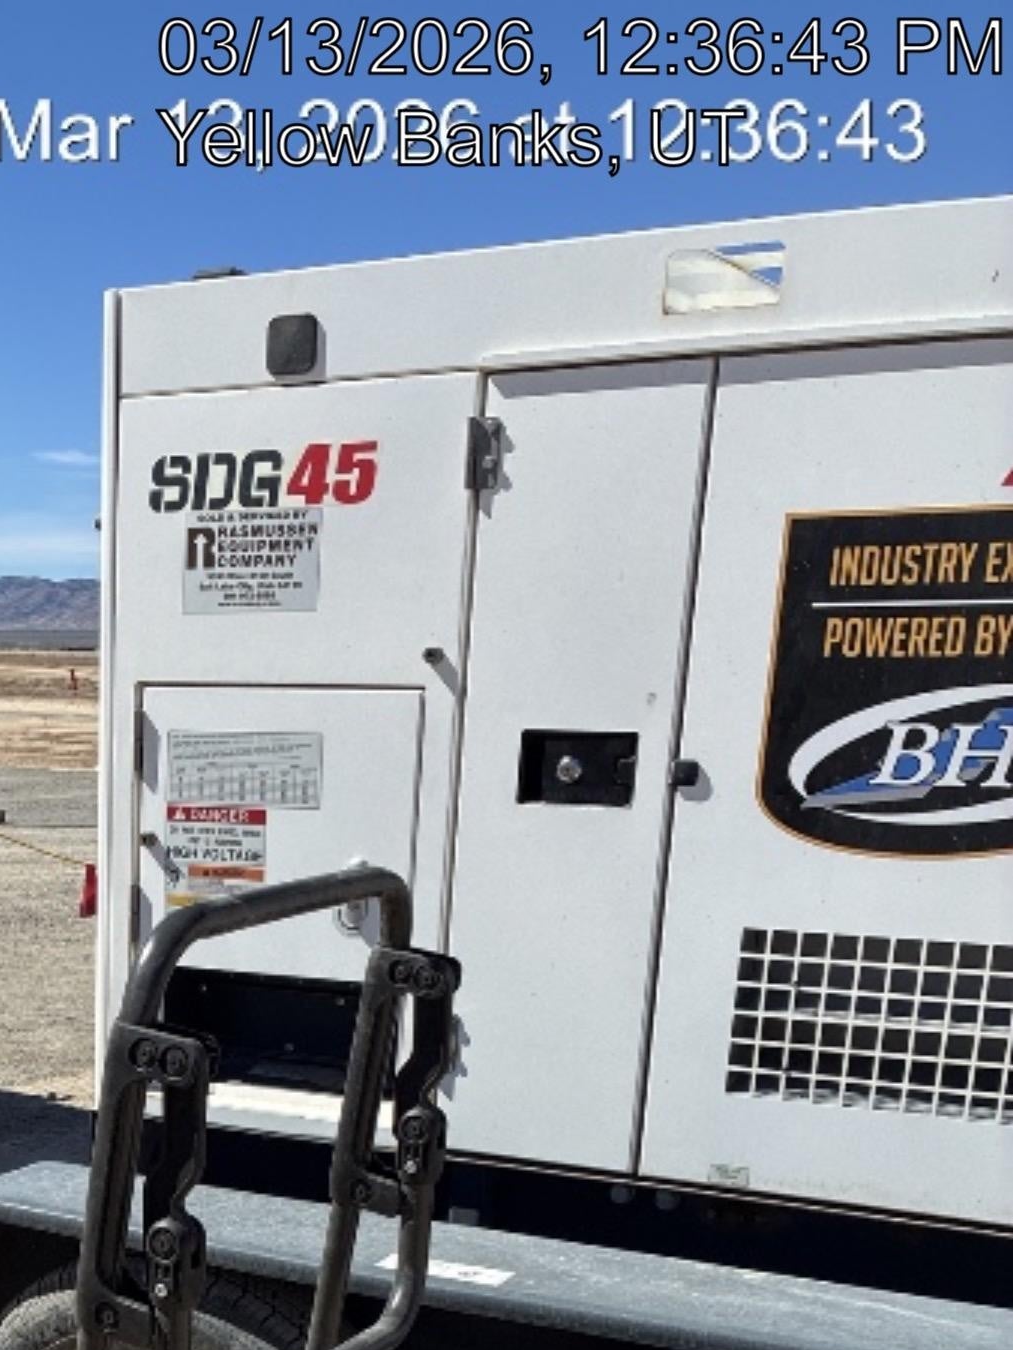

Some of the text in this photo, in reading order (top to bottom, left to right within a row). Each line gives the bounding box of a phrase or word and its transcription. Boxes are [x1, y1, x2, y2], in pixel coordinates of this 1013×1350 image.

[217, 523, 318, 538] RASMUSSEN
[217, 537, 314, 553] EQUIPMENT
[217, 553, 296, 568] COMPANY
[830, 543, 977, 586] INDUSTRY
[823, 616, 1013, 658] POWERED BY
[191, 808, 249, 823] DANGER
